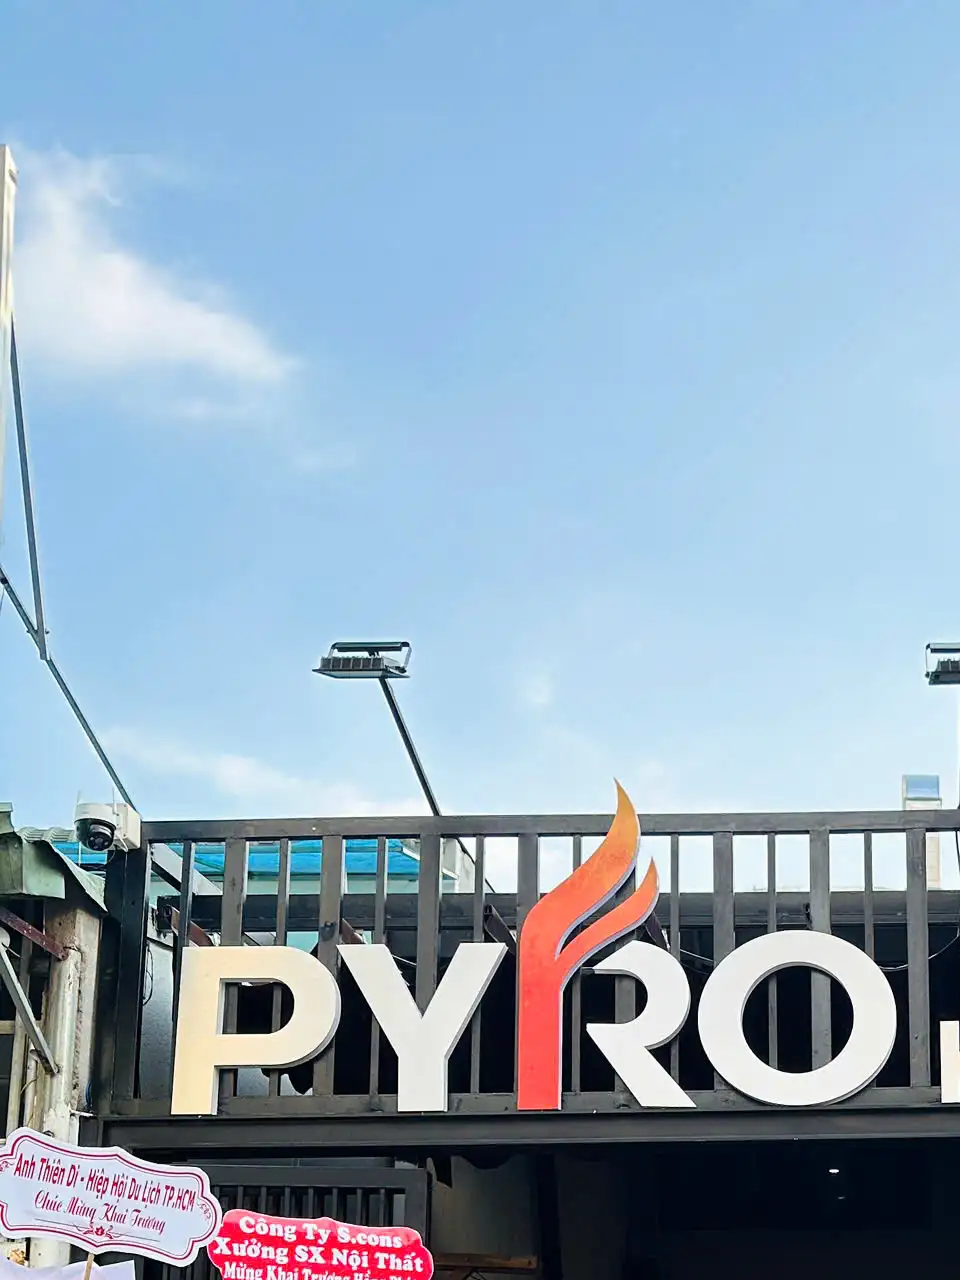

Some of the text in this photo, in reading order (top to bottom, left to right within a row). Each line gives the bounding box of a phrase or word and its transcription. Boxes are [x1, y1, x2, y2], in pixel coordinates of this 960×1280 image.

[171, 778, 897, 1116] PYRO
[14, 1153, 35, 1179] Anh
[37, 1158, 66, 1185] Thiên
[85, 1168, 110, 1200] Hiệp
[110, 1172, 128, 1203] Hội
[128, 1177, 143, 1201] Du
[142, 1180, 162, 1208] Lịch
[162, 1184, 197, 1212] TP.HCM
[35, 1190, 62, 1213] Chúc
[63, 1196, 97, 1222] Mừng
[99, 1202, 129, 1225] Khai
[239, 1216, 403, 1248] Công Ty S.cons
[213, 1236, 424, 1273] Xưởng SX Nội Thất
